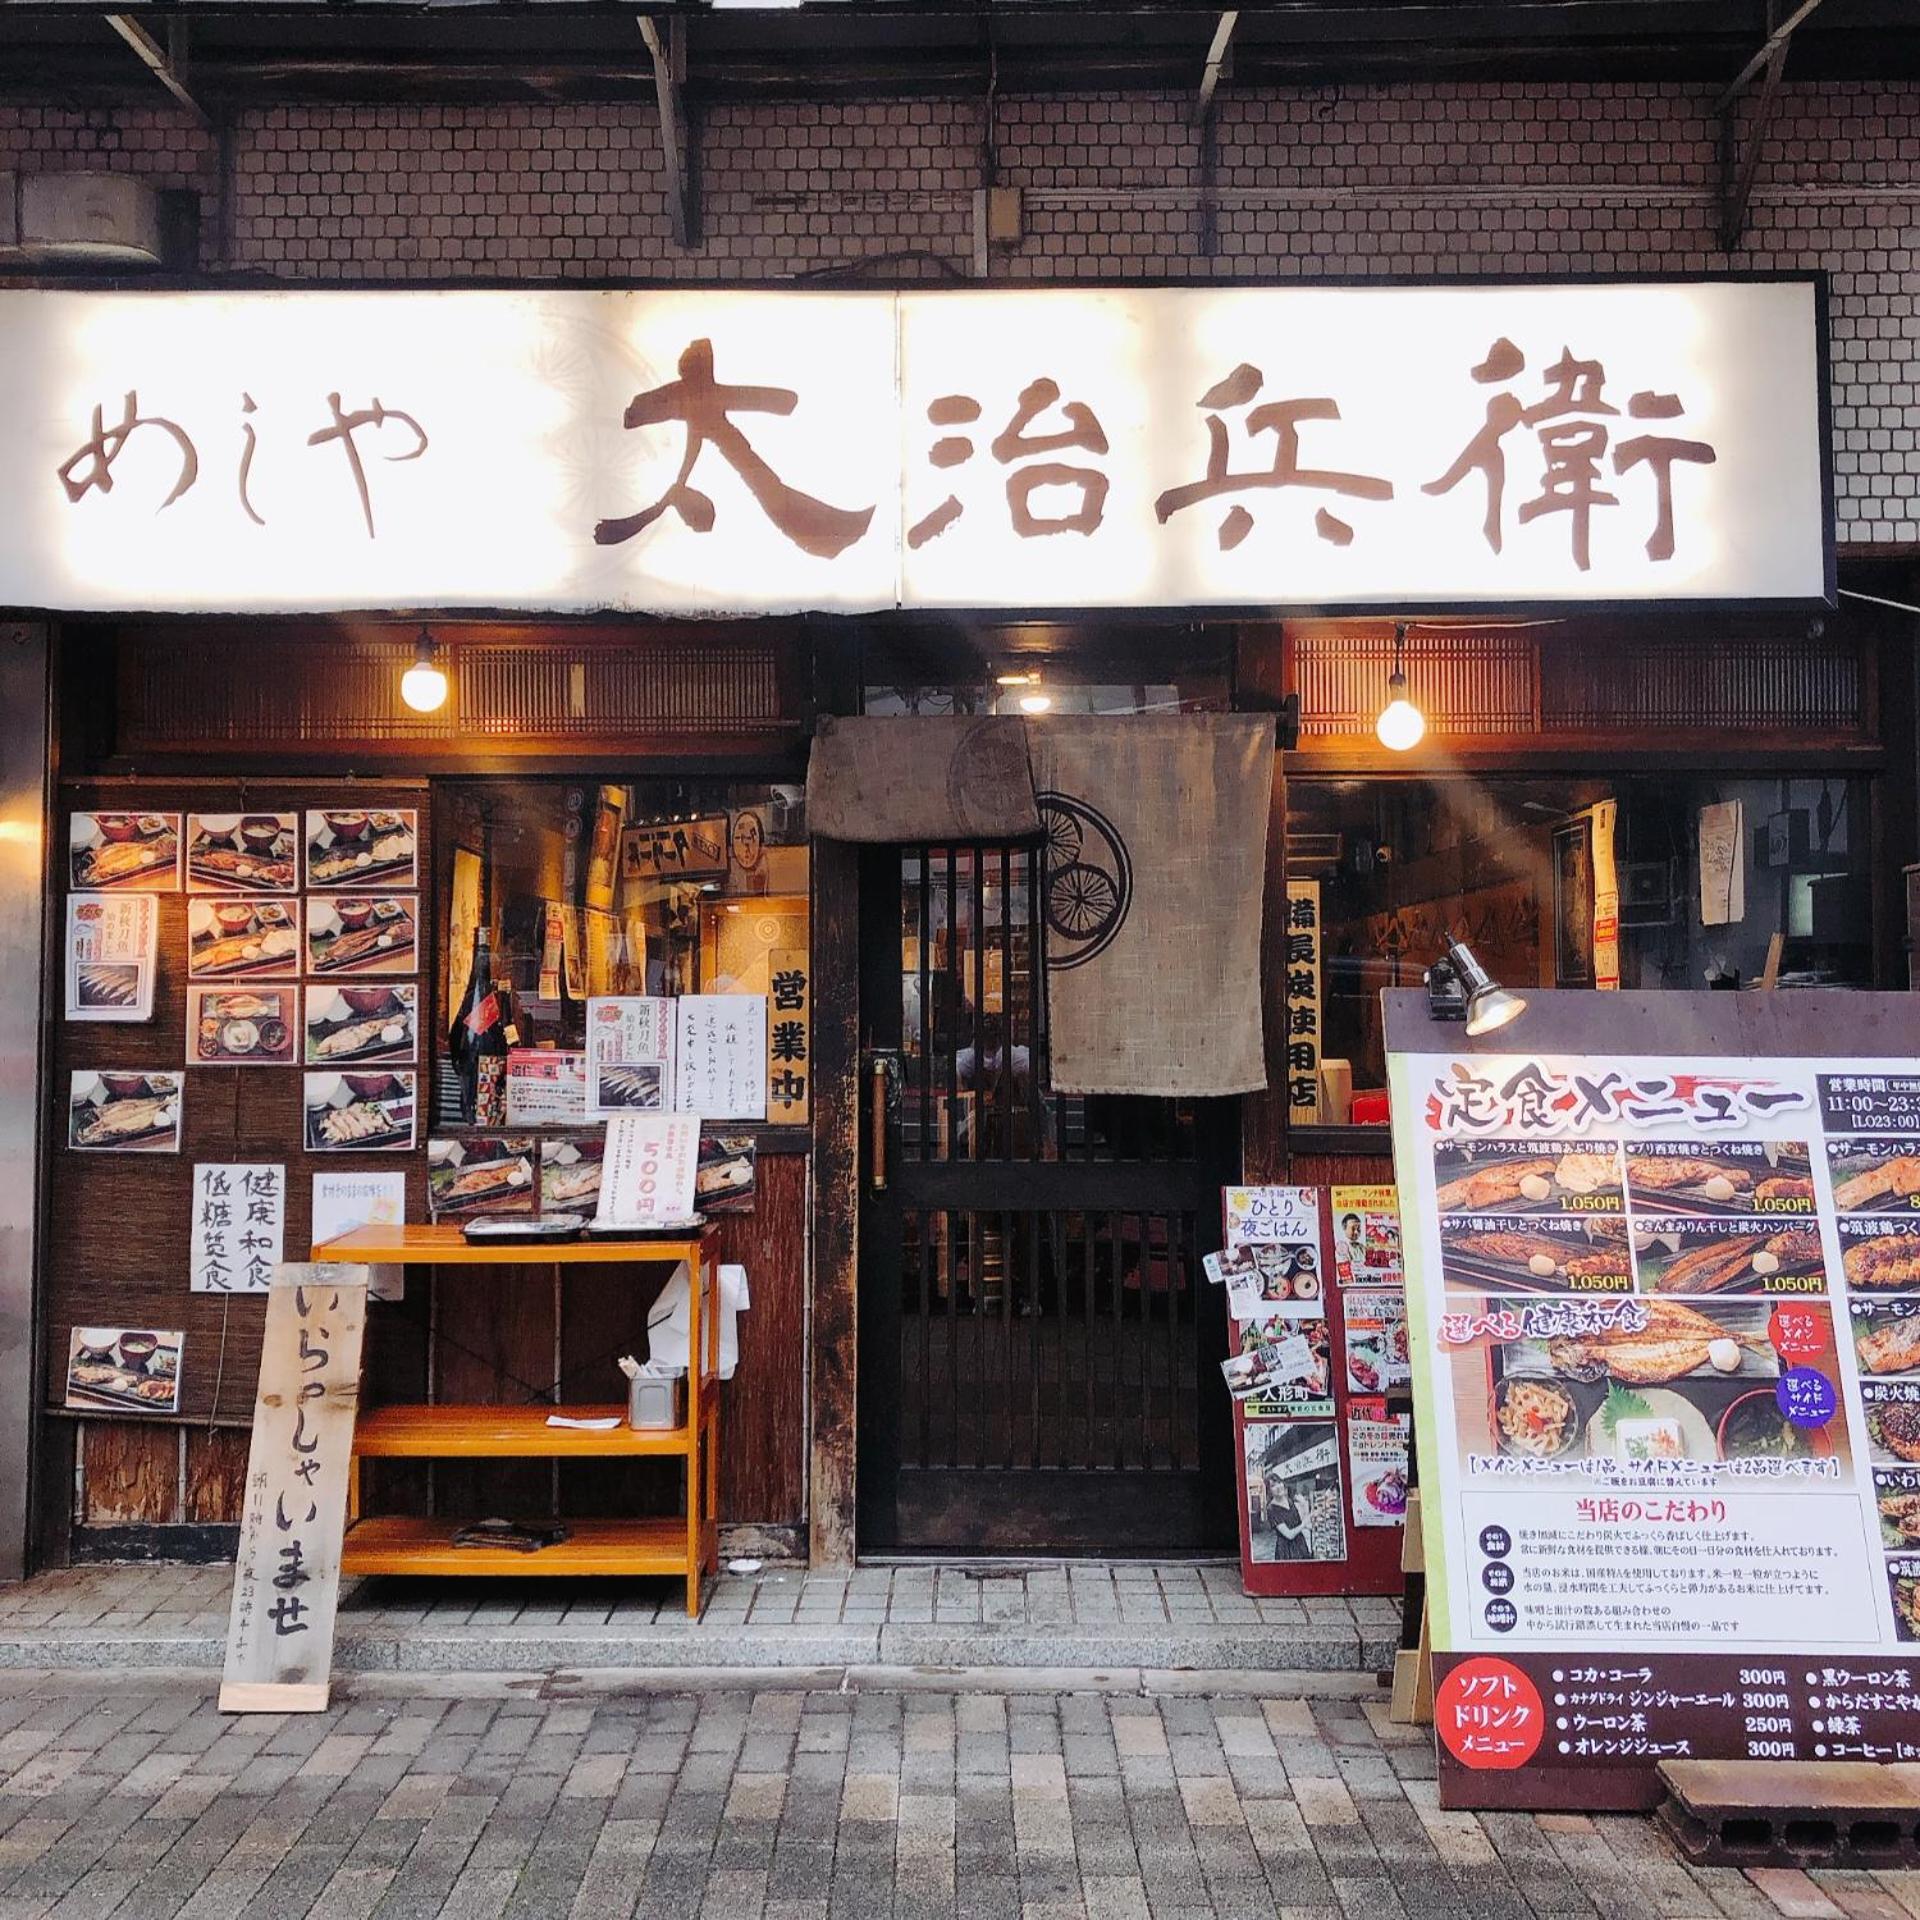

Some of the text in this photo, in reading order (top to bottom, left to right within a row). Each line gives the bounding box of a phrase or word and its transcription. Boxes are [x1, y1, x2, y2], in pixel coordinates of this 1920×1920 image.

[58, 337, 1716, 572] めしや 太治兵衛
[770, 970, 806, 1109] 営業中
[1828, 1078, 1886, 1093] 営業時間
[1434, 1062, 1806, 1130] 定食メニュー
[636, 1142, 662, 1212] 500円
[1252, 1200, 1294, 1216] ひとり
[1559, 1197, 1622, 1211] 1,050円
[1751, 1198, 1814, 1213] 1,050円
[200, 1169, 233, 1290] 低糖質食
[238, 1168, 279, 1288] 健康和食
[1241, 1219, 1308, 1238] 夜ごはん
[1567, 1275, 1629, 1291] 1,050円
[1761, 1277, 1825, 1292] 1,050円
[1442, 1299, 1647, 1343] 選べる健康和食
[1778, 1314, 1814, 1327] 選べる
[1782, 1328, 1813, 1340] メイン
[1779, 1341, 1823, 1352] メニュー
[1785, 1378, 1822, 1392] 選べる
[1790, 1392, 1823, 1403] サイド
[1788, 1405, 1831, 1418] メニュー
[268, 1286, 339, 1636] いらっしゃいませ
[1576, 1498, 1727, 1523] 当店のこだわり
[1570, 1667, 1786, 1686] コカ・コーラ 300円
[1822, 1669, 1911, 1688] 黒ウーロン茶
[1460, 1675, 1517, 1698] ソフト
[1628, 1689, 1735, 1709] ジンジャーエール
[1743, 1693, 1790, 1710] 300円
[1454, 1704, 1531, 1729] ドリンク
[1572, 1713, 1792, 1734] ウーロン茶 250円
[1827, 1717, 1862, 1735] 緑茶
[1460, 1734, 1525, 1753] メニュー
[1575, 1738, 1795, 1757] オレンジジュース 300円
